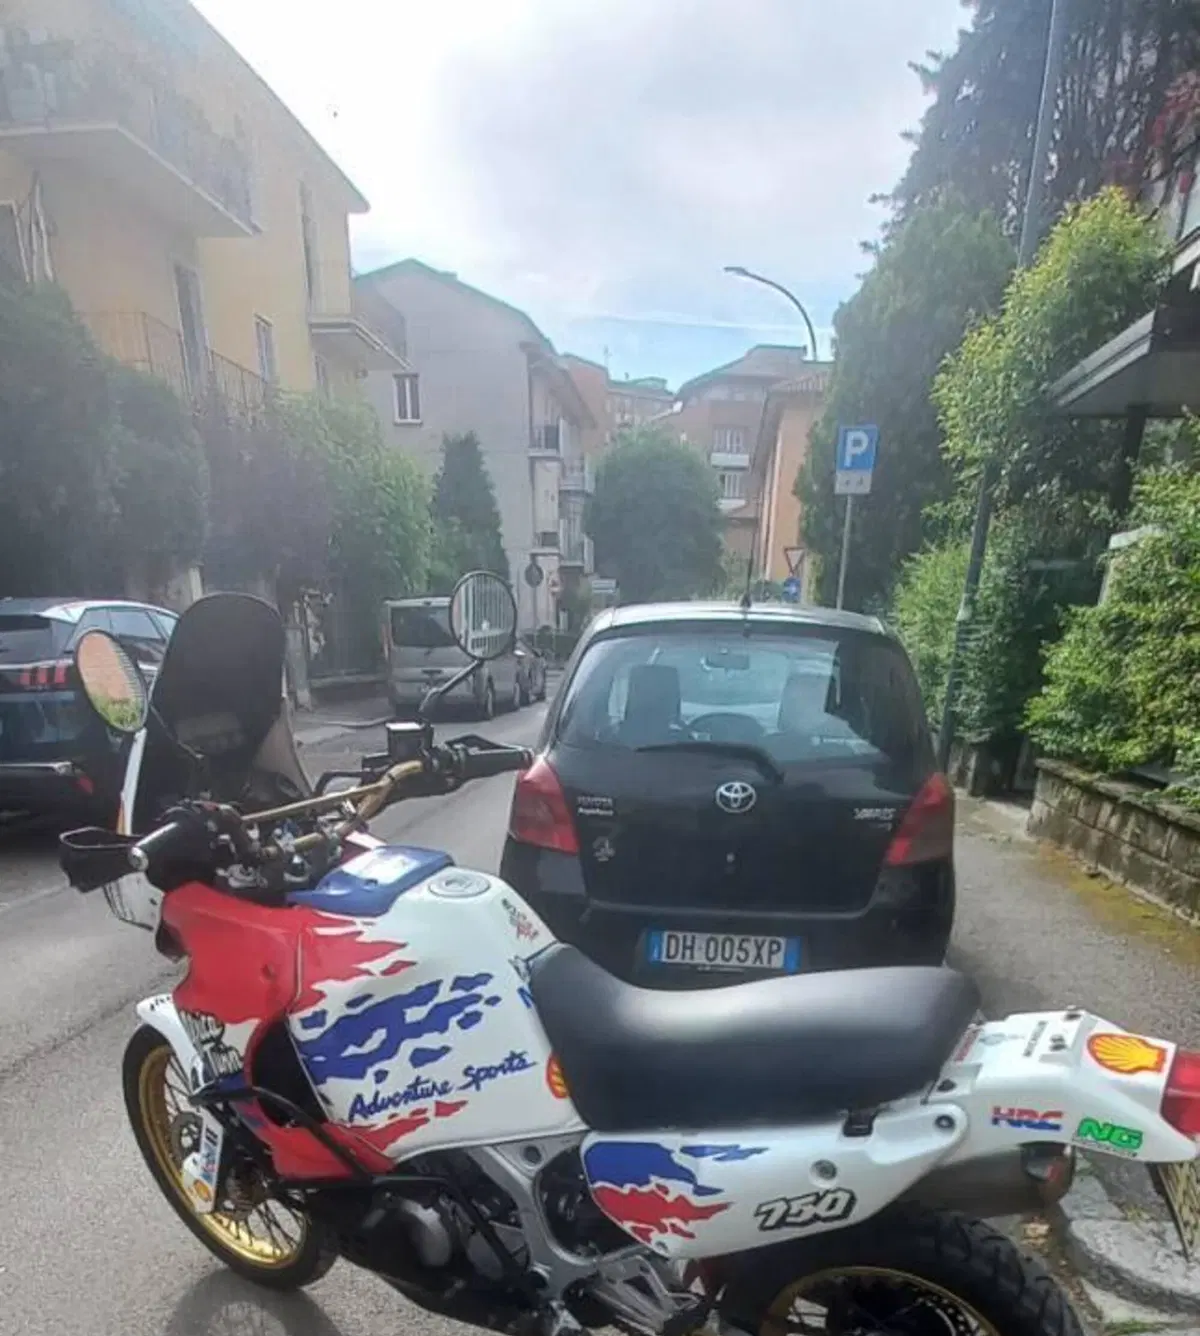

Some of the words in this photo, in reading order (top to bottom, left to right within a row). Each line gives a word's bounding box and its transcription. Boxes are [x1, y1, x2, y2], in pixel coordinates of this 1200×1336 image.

[844, 430, 868, 467] P
[666, 934, 696, 960] DH
[705, 936, 782, 965] 005XP
[348, 1076, 454, 1123] Adventure
[458, 1050, 537, 1091] Sports
[992, 1106, 1063, 1131] HRC
[1077, 1117, 1143, 1149] NG
[754, 1187, 857, 1232] 750
